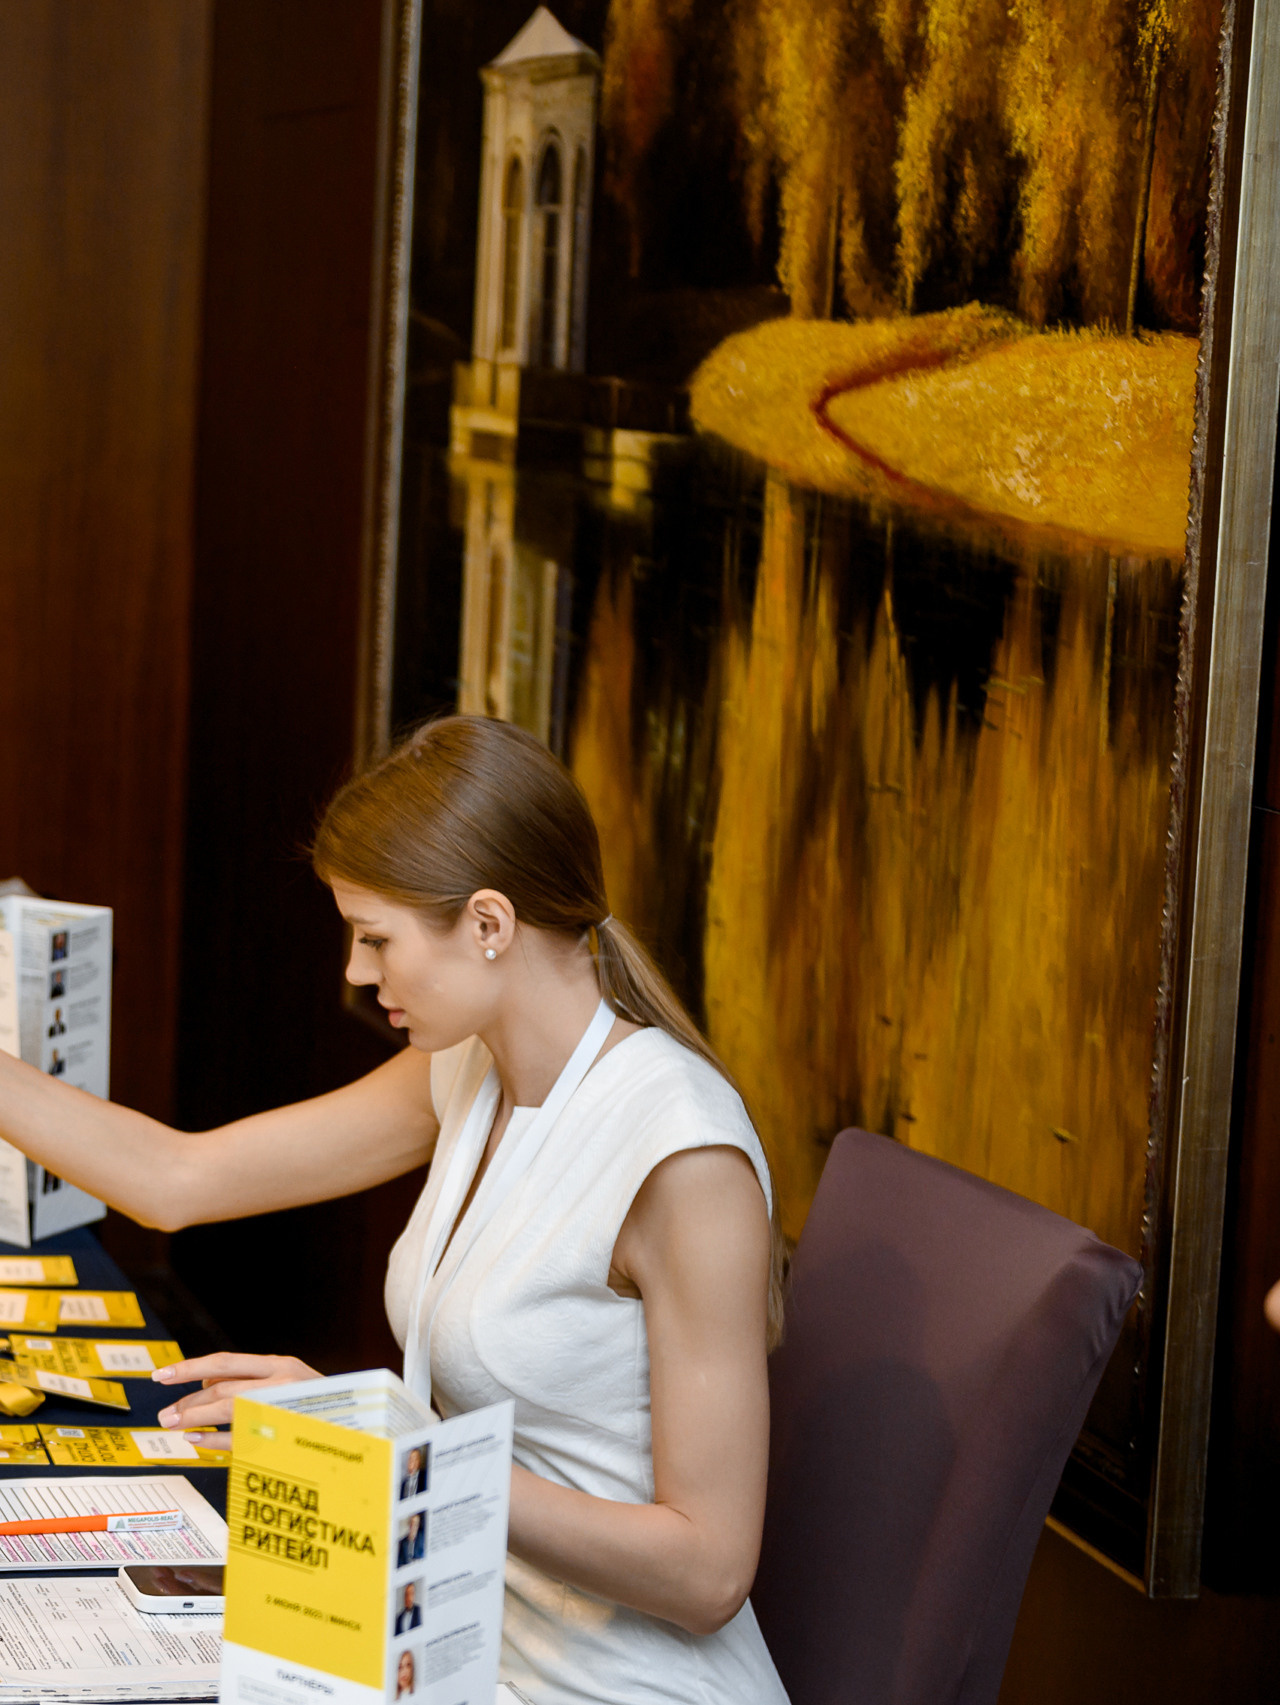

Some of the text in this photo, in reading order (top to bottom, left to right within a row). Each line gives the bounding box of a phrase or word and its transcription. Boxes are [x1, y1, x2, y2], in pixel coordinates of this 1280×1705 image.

[246, 1472, 319, 1515] СКЛАД
[243, 1525, 329, 1569] РИТЕЙЛ
[244, 1500, 376, 1556] ЛОГИСТИКА
